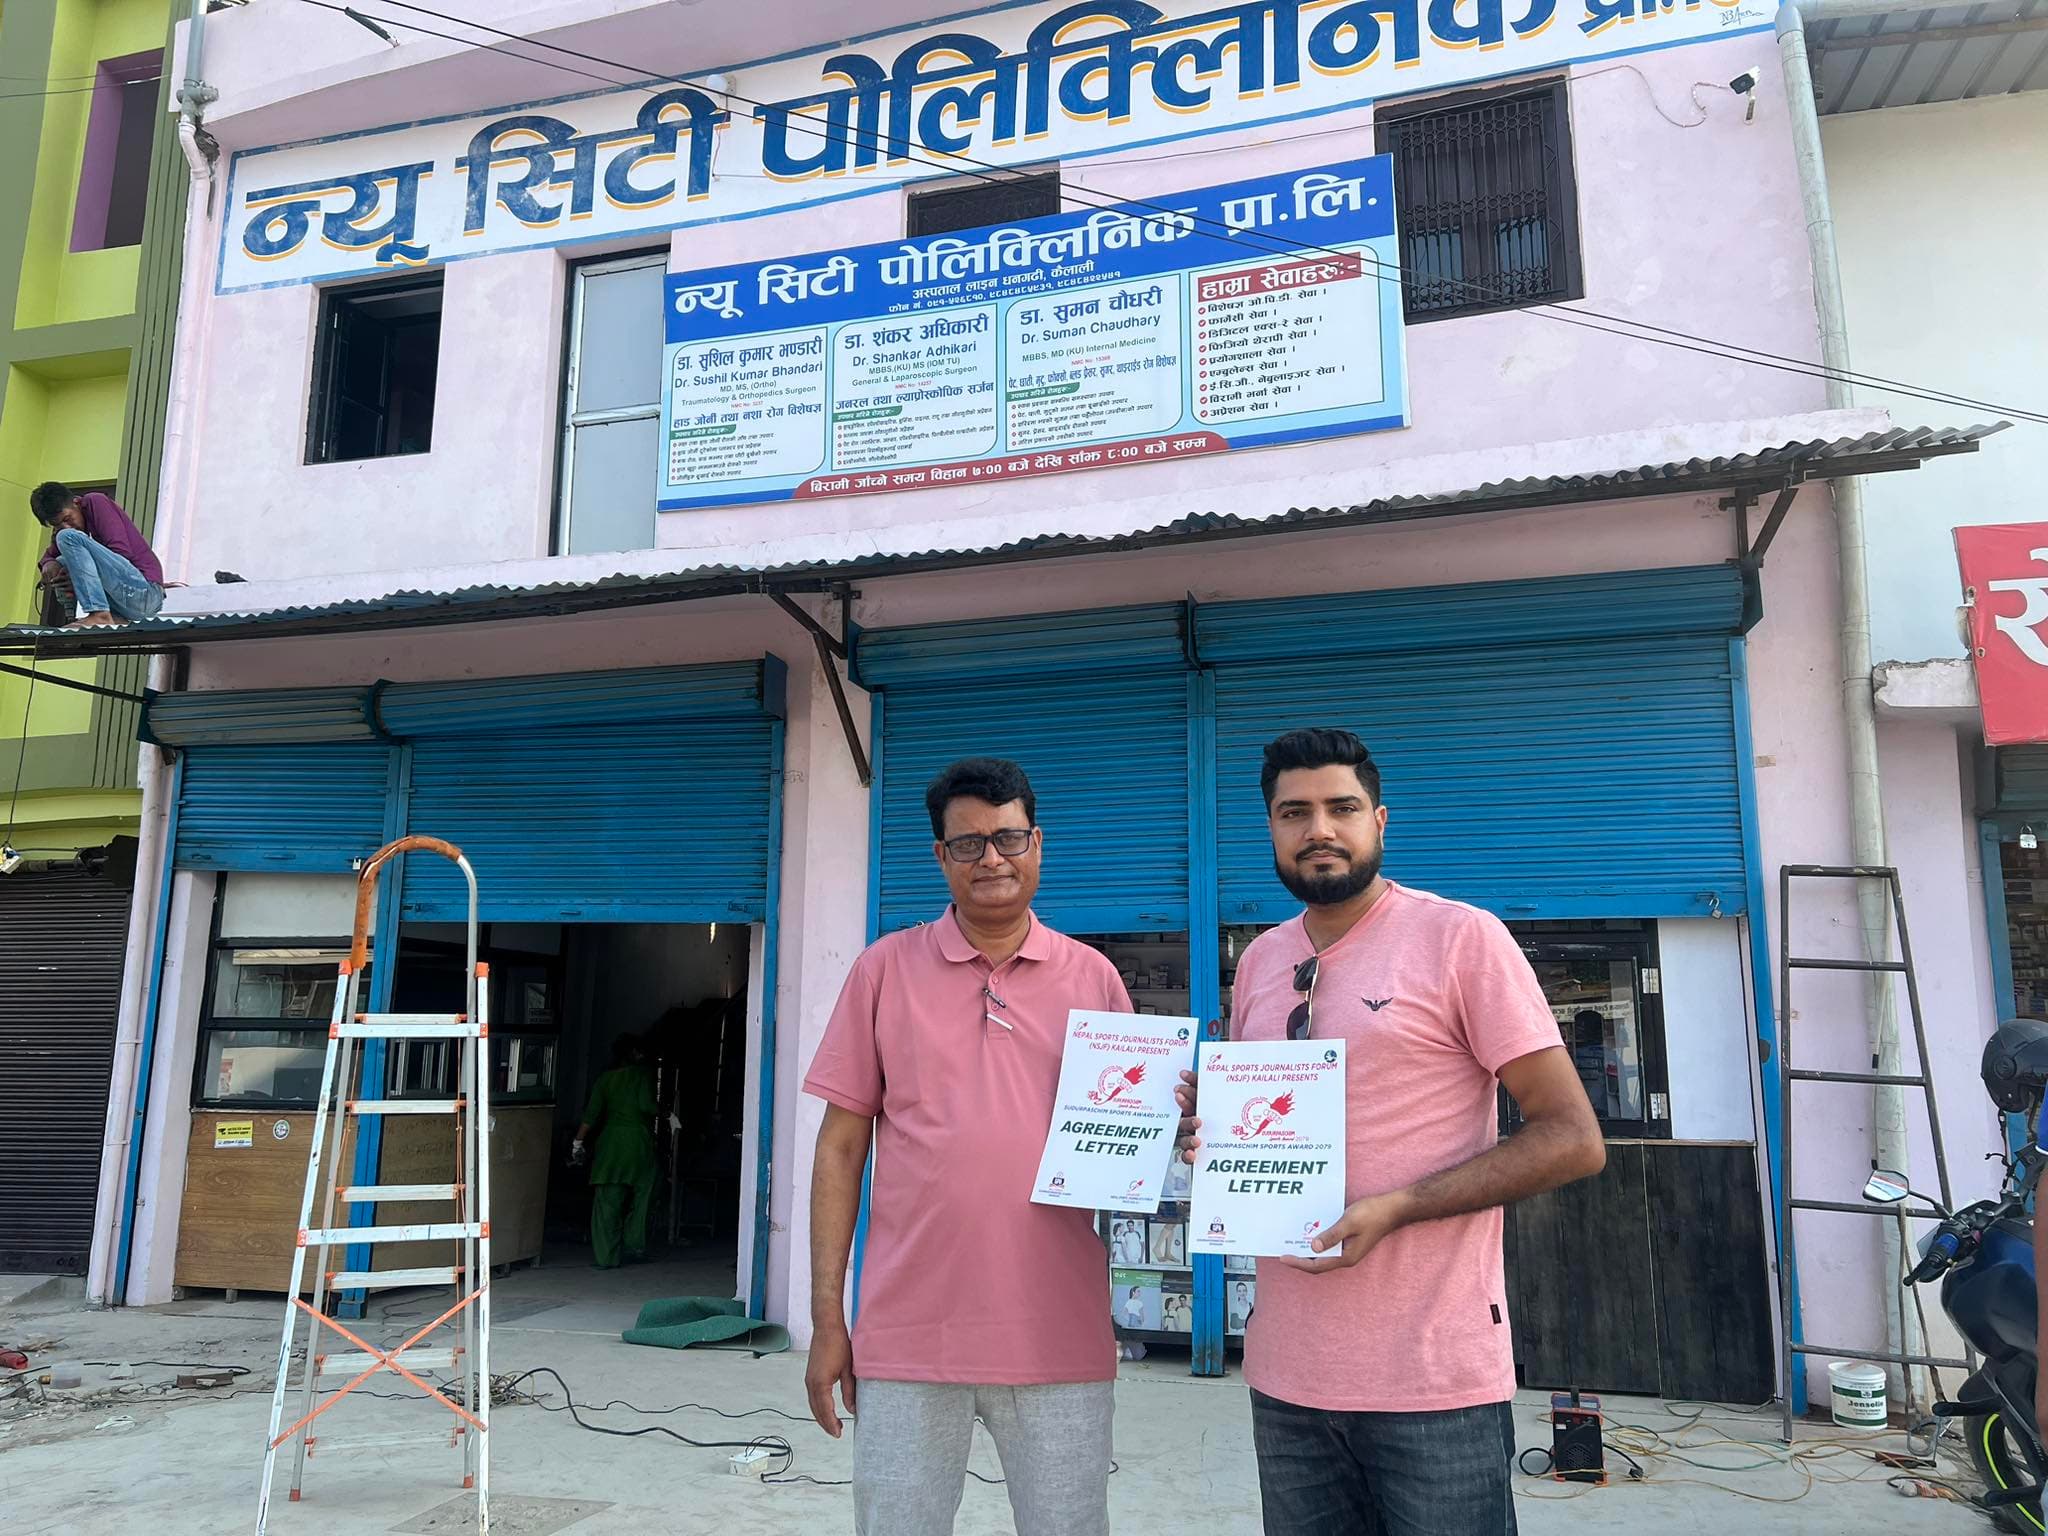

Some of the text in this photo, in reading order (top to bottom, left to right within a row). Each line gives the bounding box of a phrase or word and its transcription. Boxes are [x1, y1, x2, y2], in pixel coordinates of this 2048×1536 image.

[241, 160, 434, 267] न्यू
[455, 87, 731, 236] सिटी
[675, 173, 1377, 319] न्यू सिटी पोलिक्लिनिक प्रा.लि.
[912, 282, 961, 299] अस्पताल
[966, 277, 998, 292] लाइन
[1202, 275, 1251, 299] हाम्रा
[1020, 285, 1163, 326] डा. सुमन चौधरी
[1208, 301, 1244, 314] विशेषज्ञ
[1297, 288, 1317, 300] सेवा
[1248, 310, 1268, 321] सेवा
[844, 312, 990, 350] डा. शंकर अधिकारी
[1021, 314, 1161, 345] Dr. Suman Chaudhary
[1208, 325, 1249, 340] डिजिटल
[1293, 316, 1313, 326] सेवा
[1022, 336, 1157, 362] MBBS, MD (KU) Internal Medicine
[1208, 330, 1307, 352] फिजियो थेरापी सेवा
[677, 335, 823, 372] डा. सुशिल कुमार भण्डारी
[852, 341, 977, 368] Dr. Shankar Adhikari
[912, 360, 925, 369] MS
[1209, 346, 1286, 365] प्रयोगशाला सेवा
[674, 361, 823, 389] Dr. Sushil Kumar Bhandari
[852, 365, 978, 387] General & Laparoscopic Surgeon
[1258, 361, 1278, 372] सेवा
[1315, 365, 1336, 377] सेवा
[682, 395, 730, 407] Traumatology
[738, 388, 784, 402] Orthopedics
[785, 385, 817, 397] Surgeon
[750, 380, 777, 391] (Ortho)
[835, 397, 869, 410] जनरल
[873, 394, 892, 406] तथा
[967, 380, 995, 396] सर्जन
[1272, 385, 1291, 396] सेवा
[673, 416, 690, 429] हाड
[720, 411, 739, 424] तथा
[766, 405, 784, 419] रोग
[787, 402, 823, 416] विशेषज्ञ
[1210, 401, 1269, 418] अप्रेशन सेवा
[810, 477, 850, 493] बिरामी
[892, 471, 925, 486] समय
[1008, 457, 1030, 473] बजे
[1034, 453, 1062, 470] देखि
[1144, 439, 1167, 454] बजे
[1172, 437, 1207, 452] सम्म
[1072, 1030, 1189, 1048] NEPAL SPORTS JOURNALISTS FORUM
[1089, 1042, 1170, 1056] (NSJF) KAILALI PRESENTS
[1206, 1062, 1338, 1073] NEPAL SPORTS JOURNALISTS FORUM
[1226, 1073, 1318, 1083] (NSJF) KAILALI PRESENTS
[1064, 1105, 1109, 1114] SUDURPASCHIM
[1109, 1108, 1132, 1116] SPORTS
[1060, 1120, 1163, 1140] AGREEMENT
[1074, 1140, 1139, 1156] LETTER
[1206, 1159, 1328, 1175] AGREEMENT
[1228, 1180, 1304, 1195] LETTER
